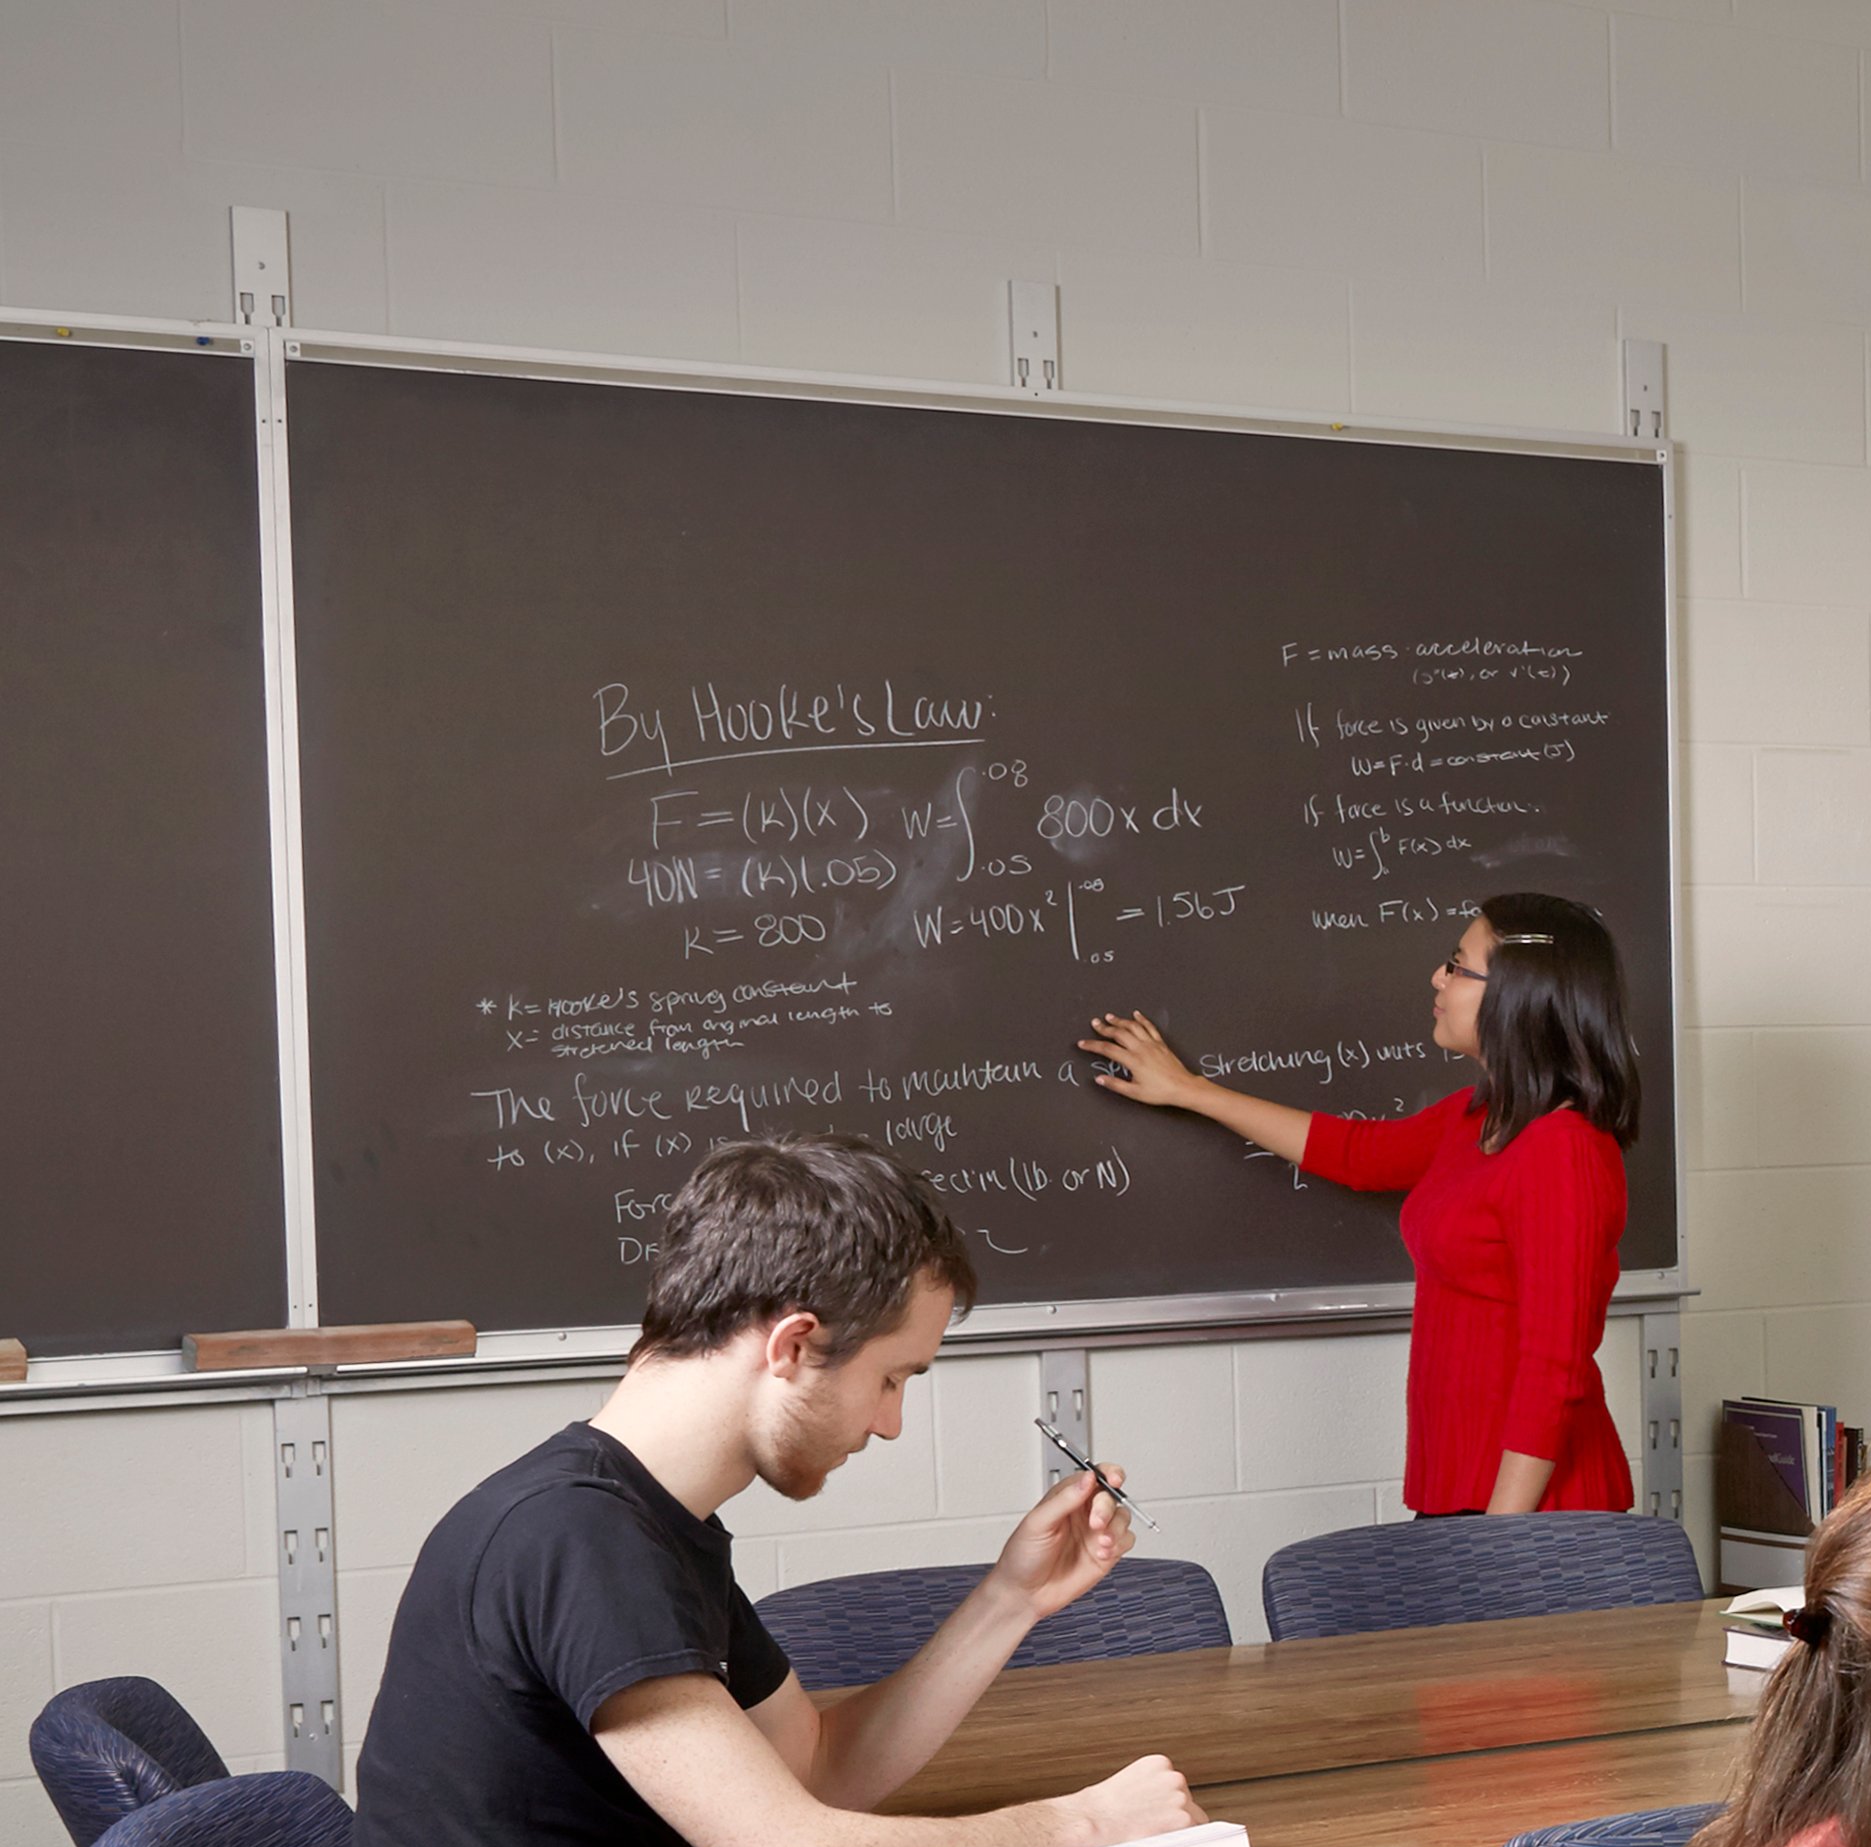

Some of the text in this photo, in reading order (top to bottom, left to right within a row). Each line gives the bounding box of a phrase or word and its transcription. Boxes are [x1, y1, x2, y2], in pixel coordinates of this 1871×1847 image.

[1328, 644, 1398, 661] mass
[594, 683, 672, 776] By
[1337, 709, 1382, 740] force
[1390, 720, 1408, 735] is
[1416, 716, 1465, 743] given
[1472, 712, 1494, 732] by
[1337, 795, 1386, 824] force
[1395, 799, 1414, 816] is
[471, 1088, 556, 1129] The
[572, 1072, 672, 1128] force
[886, 1113, 958, 1152] large
